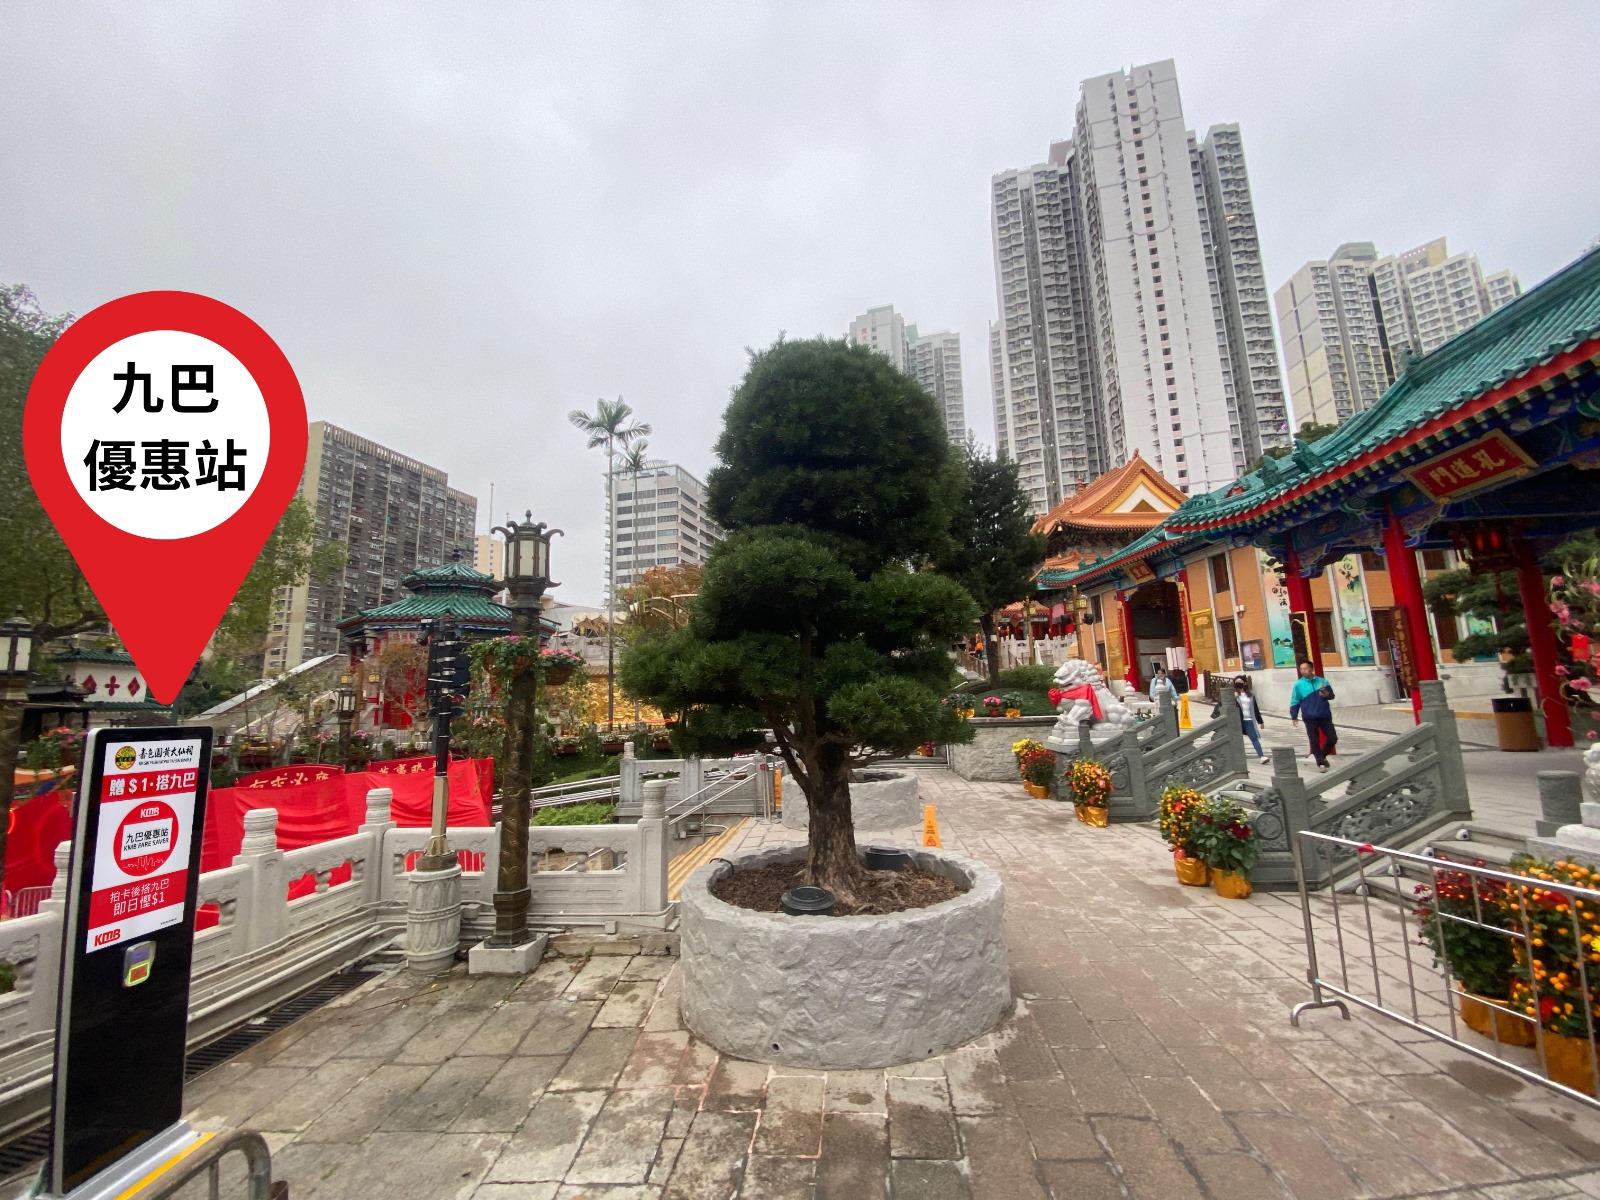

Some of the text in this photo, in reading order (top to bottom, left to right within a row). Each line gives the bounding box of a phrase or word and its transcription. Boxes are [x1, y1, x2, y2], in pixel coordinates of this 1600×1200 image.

[140, 807, 160, 818] KMB
[126, 828, 169, 844] 九巴優惠站
[110, 878, 170, 904] 拍卡後搭九巴
[94, 928, 121, 947] KMB
